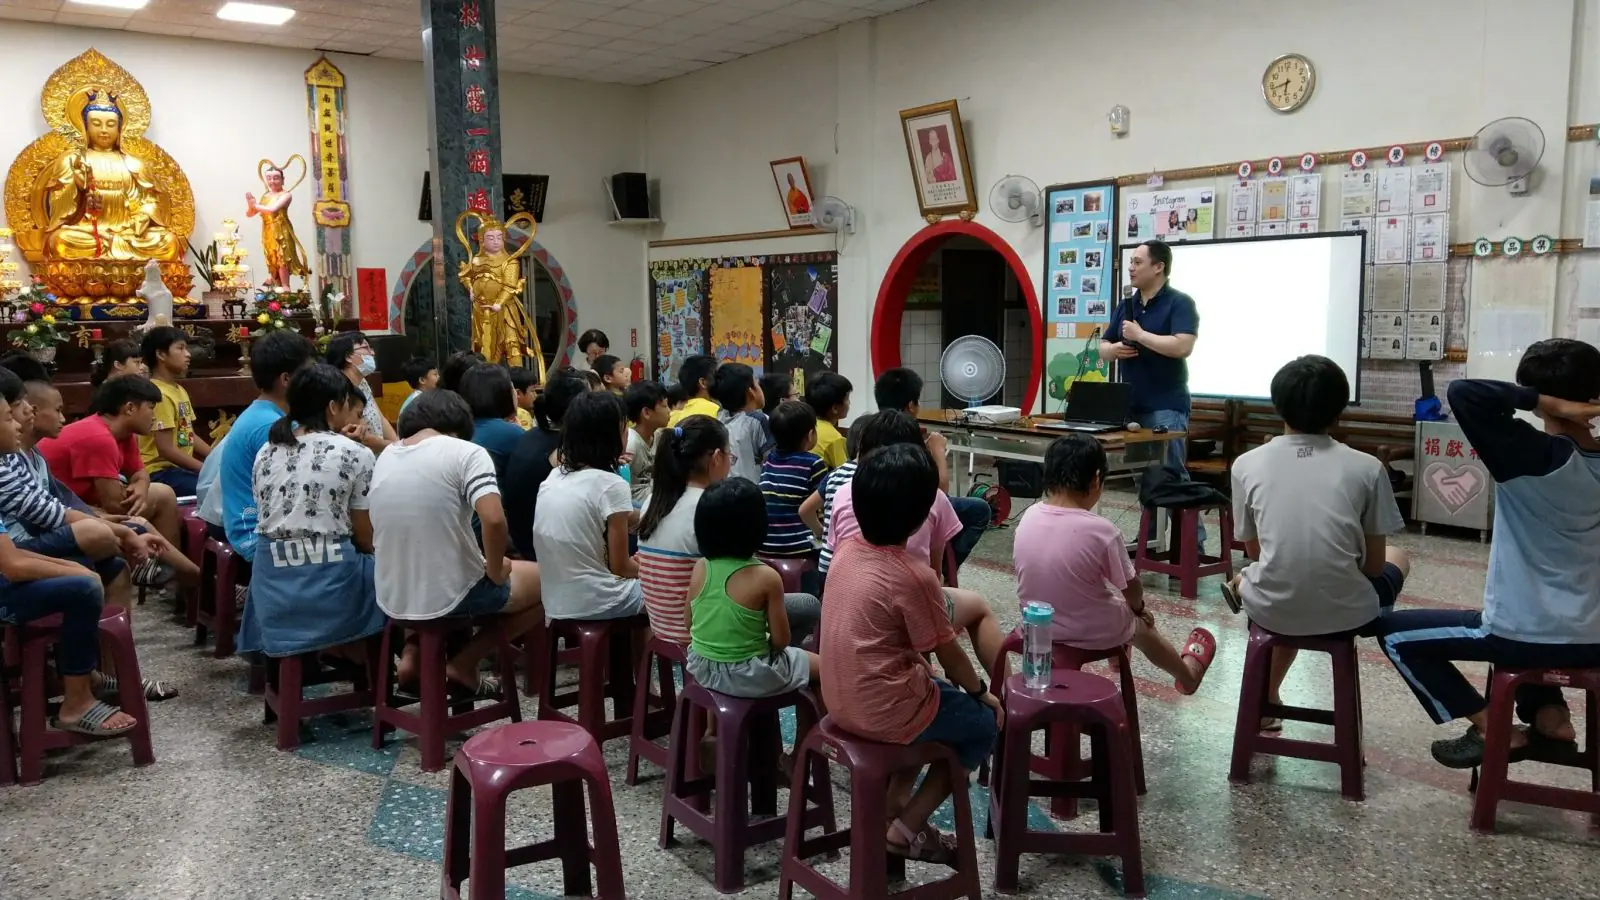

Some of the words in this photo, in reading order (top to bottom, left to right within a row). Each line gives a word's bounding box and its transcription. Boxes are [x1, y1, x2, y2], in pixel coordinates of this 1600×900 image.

[322, 93, 335, 194] 南無觀世音菩薩
[1152, 194, 1186, 209] Instagram
[1479, 240, 1546, 253] 作品集
[269, 534, 344, 568] LOVE
